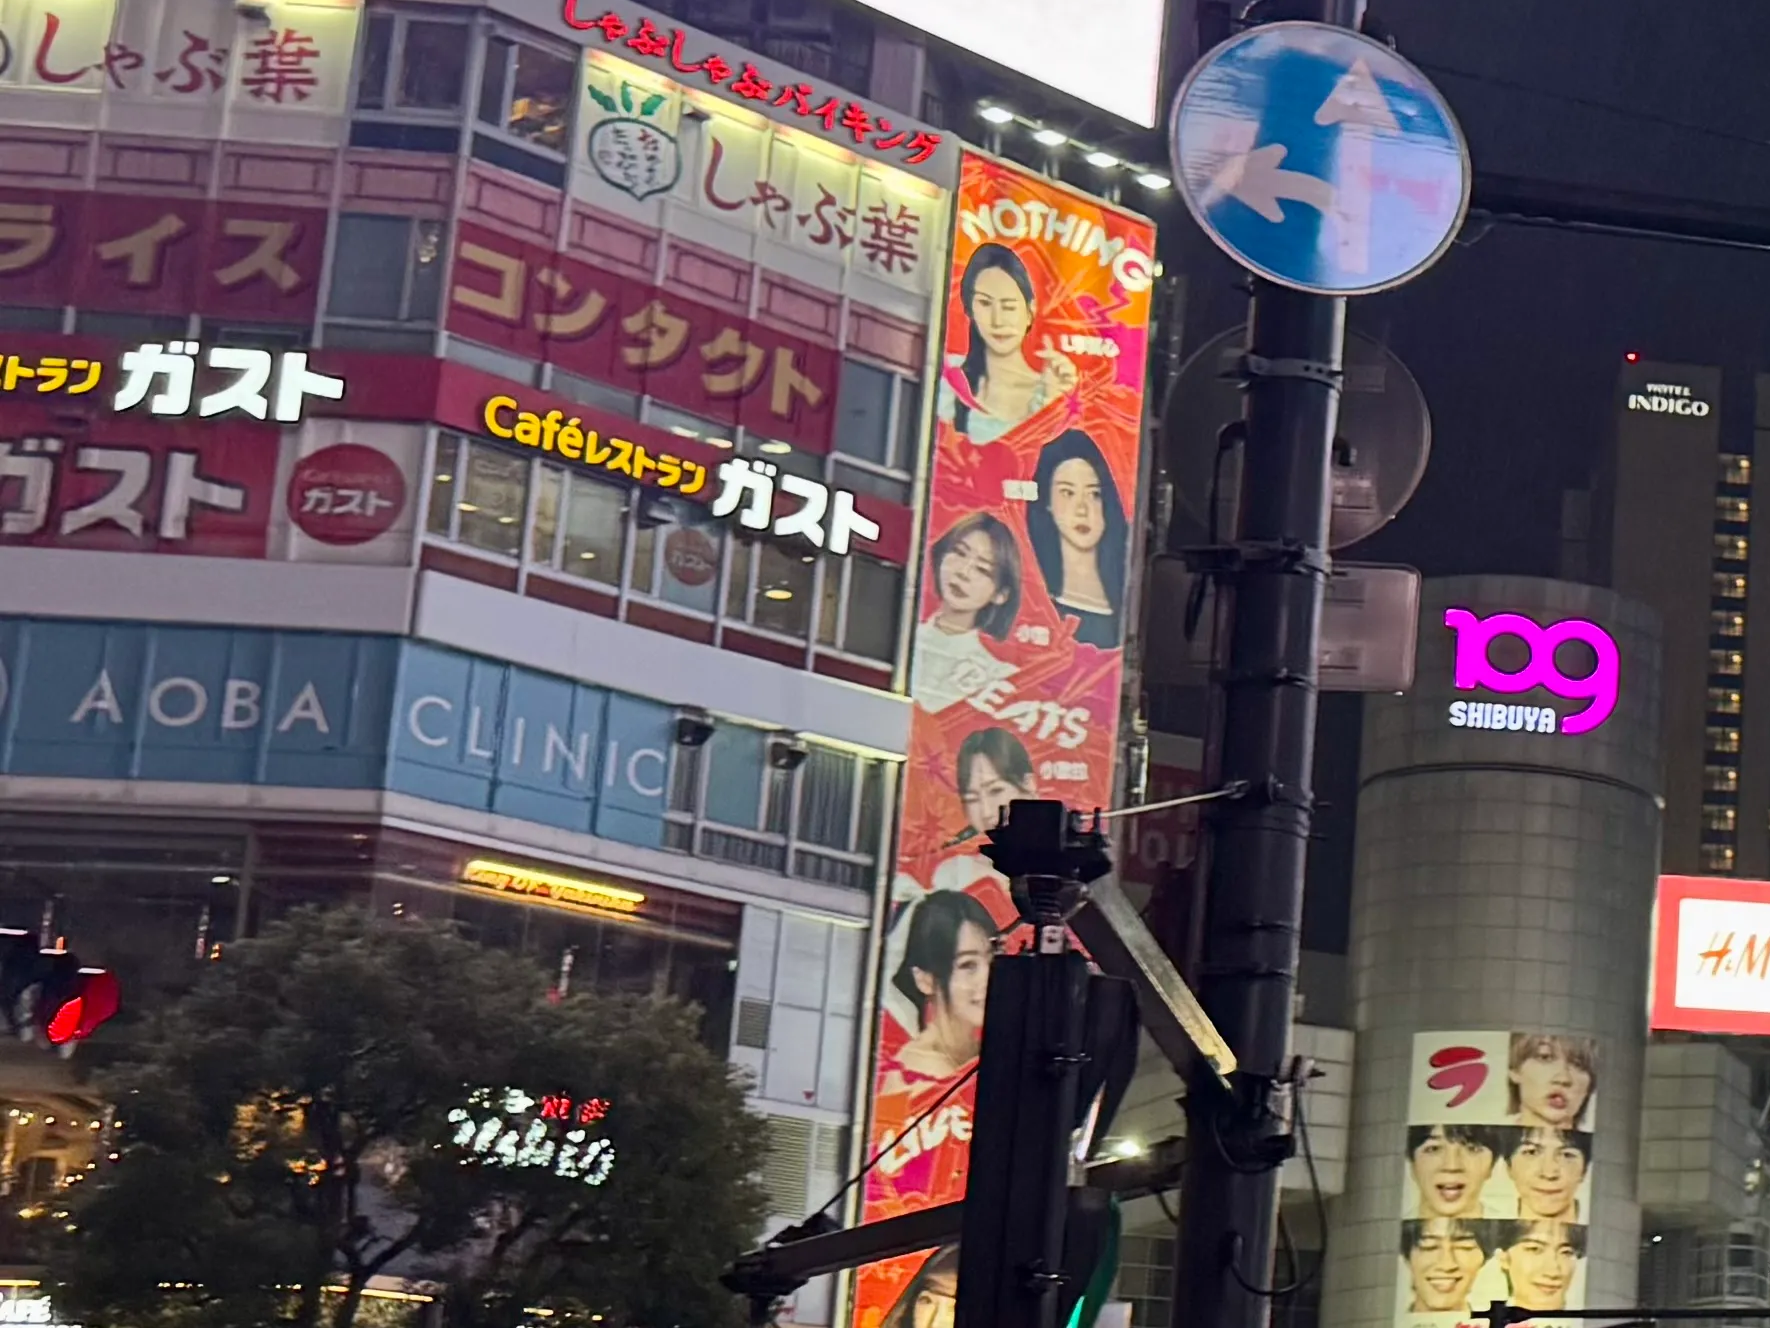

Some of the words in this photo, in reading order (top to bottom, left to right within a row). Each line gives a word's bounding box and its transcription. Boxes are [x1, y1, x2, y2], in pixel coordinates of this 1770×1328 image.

[34, 10, 322, 105] しゃぶ葉
[703, 135, 921, 276] しゃぶ葉
[961, 200, 1156, 293] NOTHING
[453, 240, 825, 417] コンタクト
[114, 341, 345, 422] ガスト
[1628, 393, 1711, 419] INDIGO
[0, 436, 245, 540] ガスト
[301, 486, 394, 515] ガスト
[713, 456, 880, 555] ガスト
[954, 658, 1091, 749] BEATS
[1445, 607, 1621, 735] 109
[1448, 700, 1557, 735] SHIBUYA
[70, 668, 330, 735] AOBA
[408, 694, 667, 798] CLINIC
